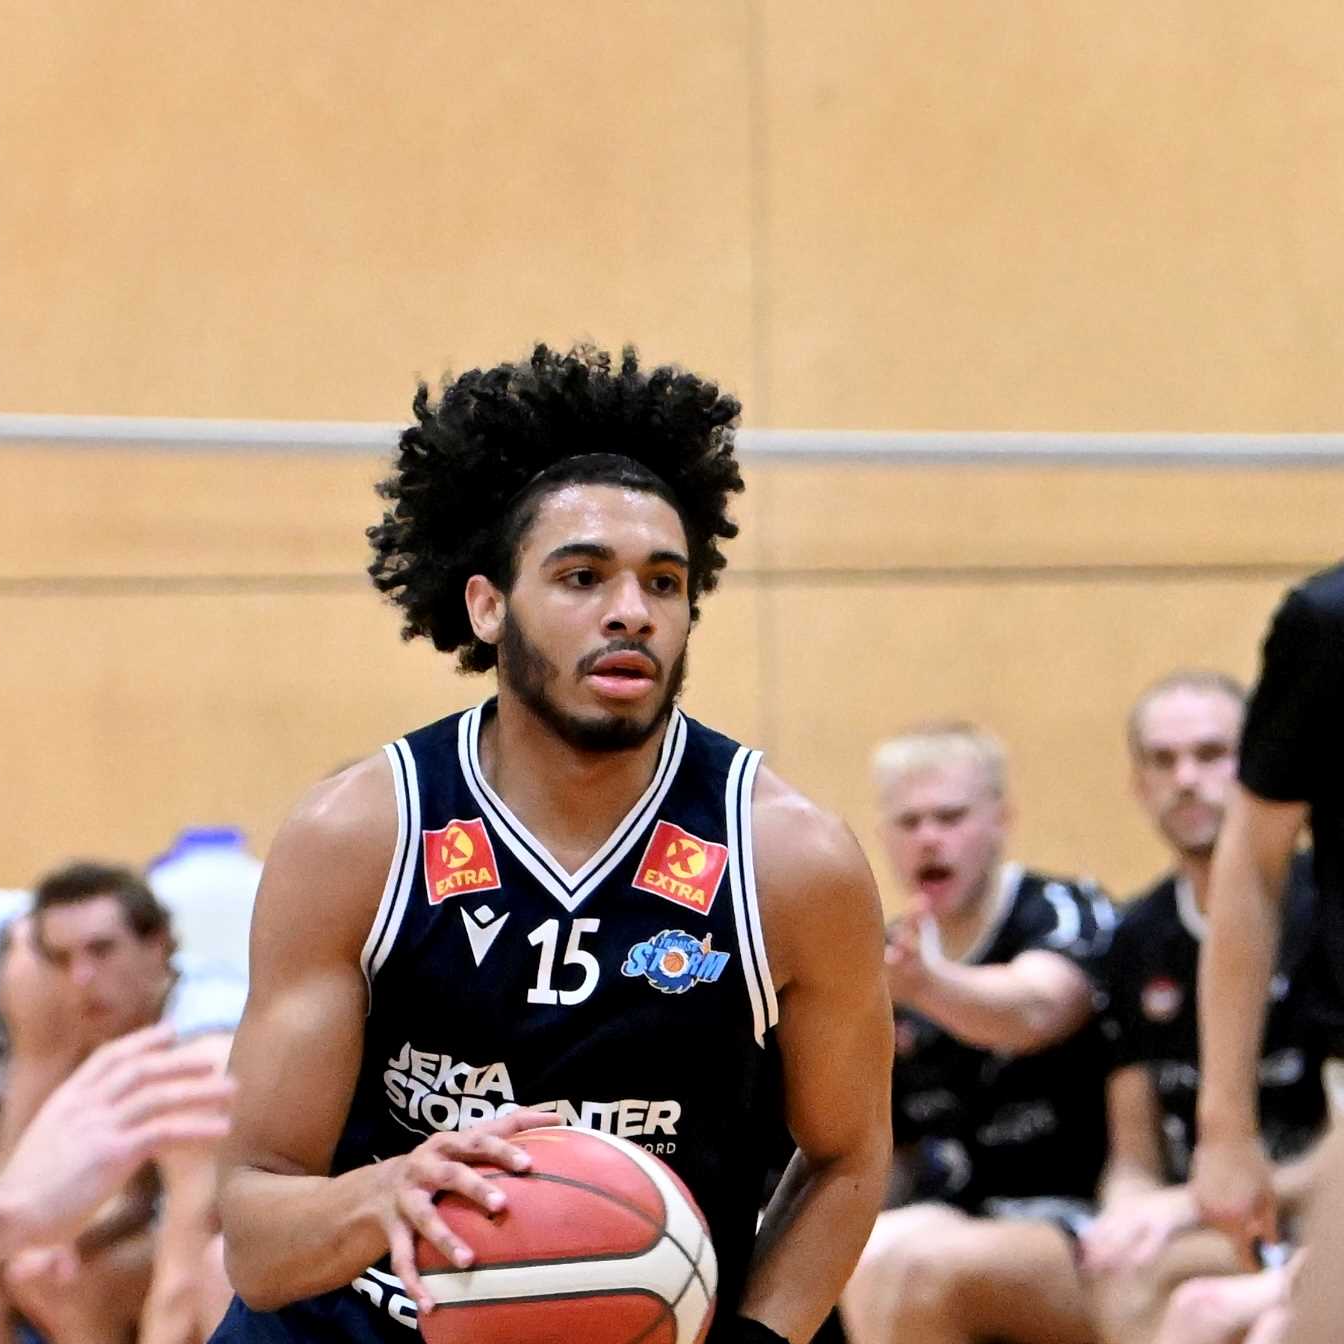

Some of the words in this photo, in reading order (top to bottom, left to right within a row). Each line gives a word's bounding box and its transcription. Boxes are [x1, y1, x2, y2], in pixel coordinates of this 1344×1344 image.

[435, 867, 492, 896] EXTRA
[643, 868, 706, 906] EXTRA
[527, 918, 601, 1006] 15
[388, 1041, 515, 1101] JEKTA
[640, 1142, 676, 1155] ORD
